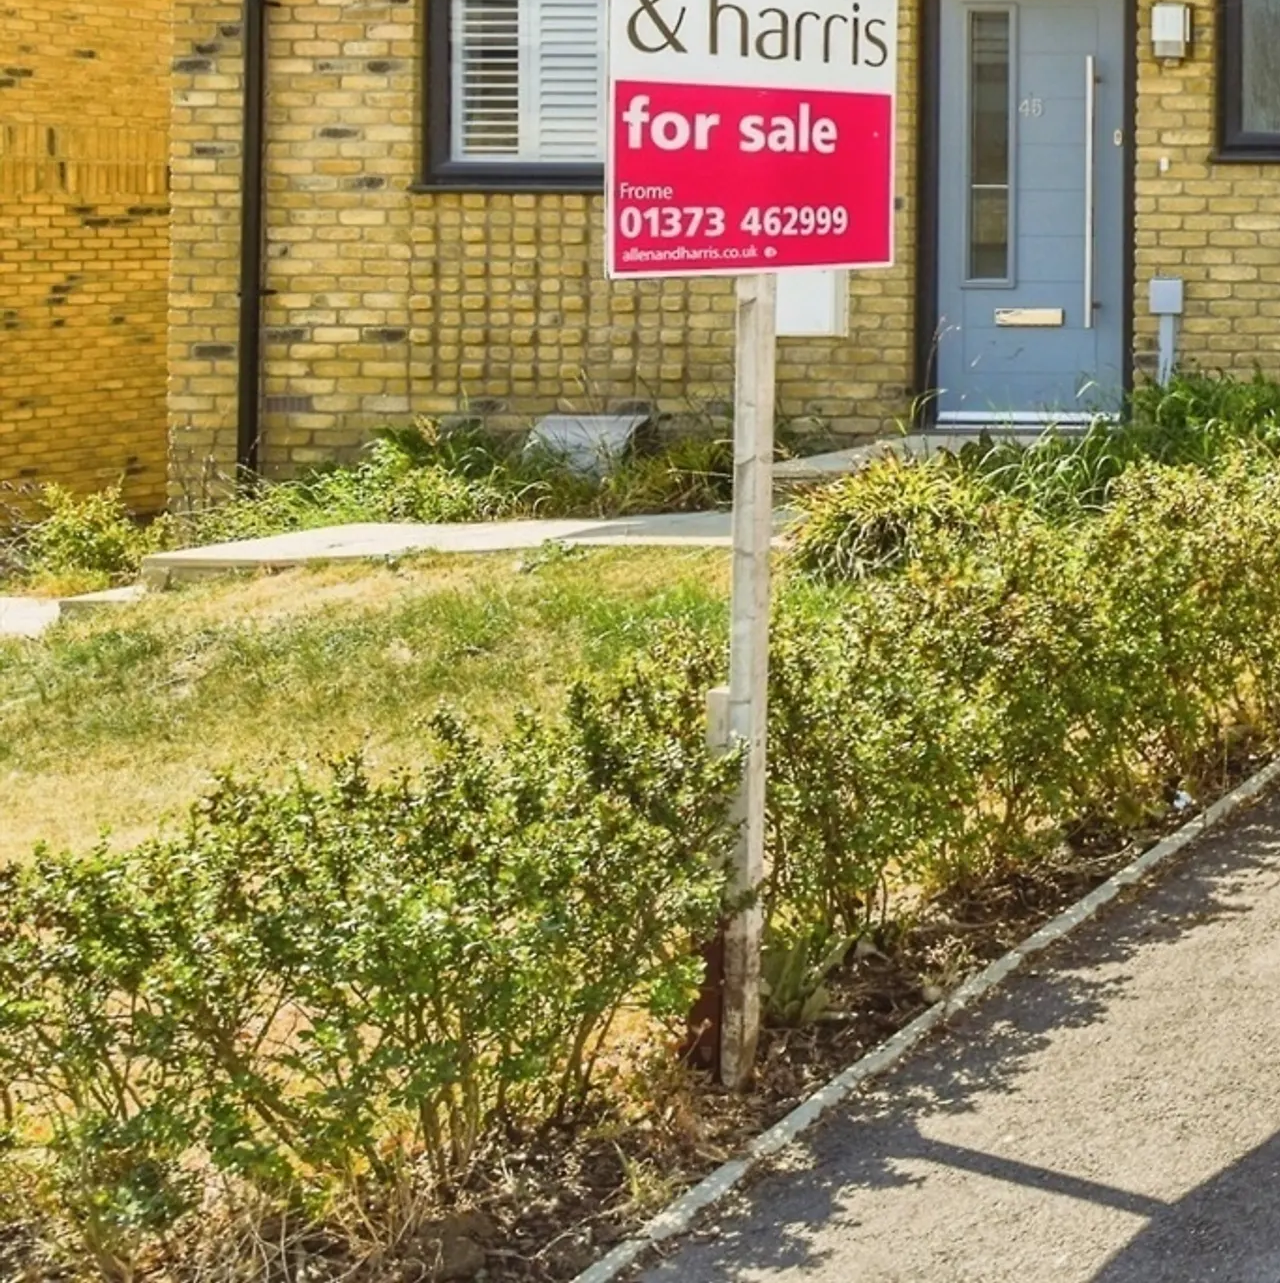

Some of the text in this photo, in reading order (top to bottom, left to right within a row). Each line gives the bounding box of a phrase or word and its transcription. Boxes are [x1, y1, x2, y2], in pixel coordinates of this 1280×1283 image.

[622, 94, 837, 154] for sale
[620, 182, 673, 200] Frome
[620, 205, 848, 239] 01373 462999
[622, 245, 758, 263] allenandharris.co.uk
